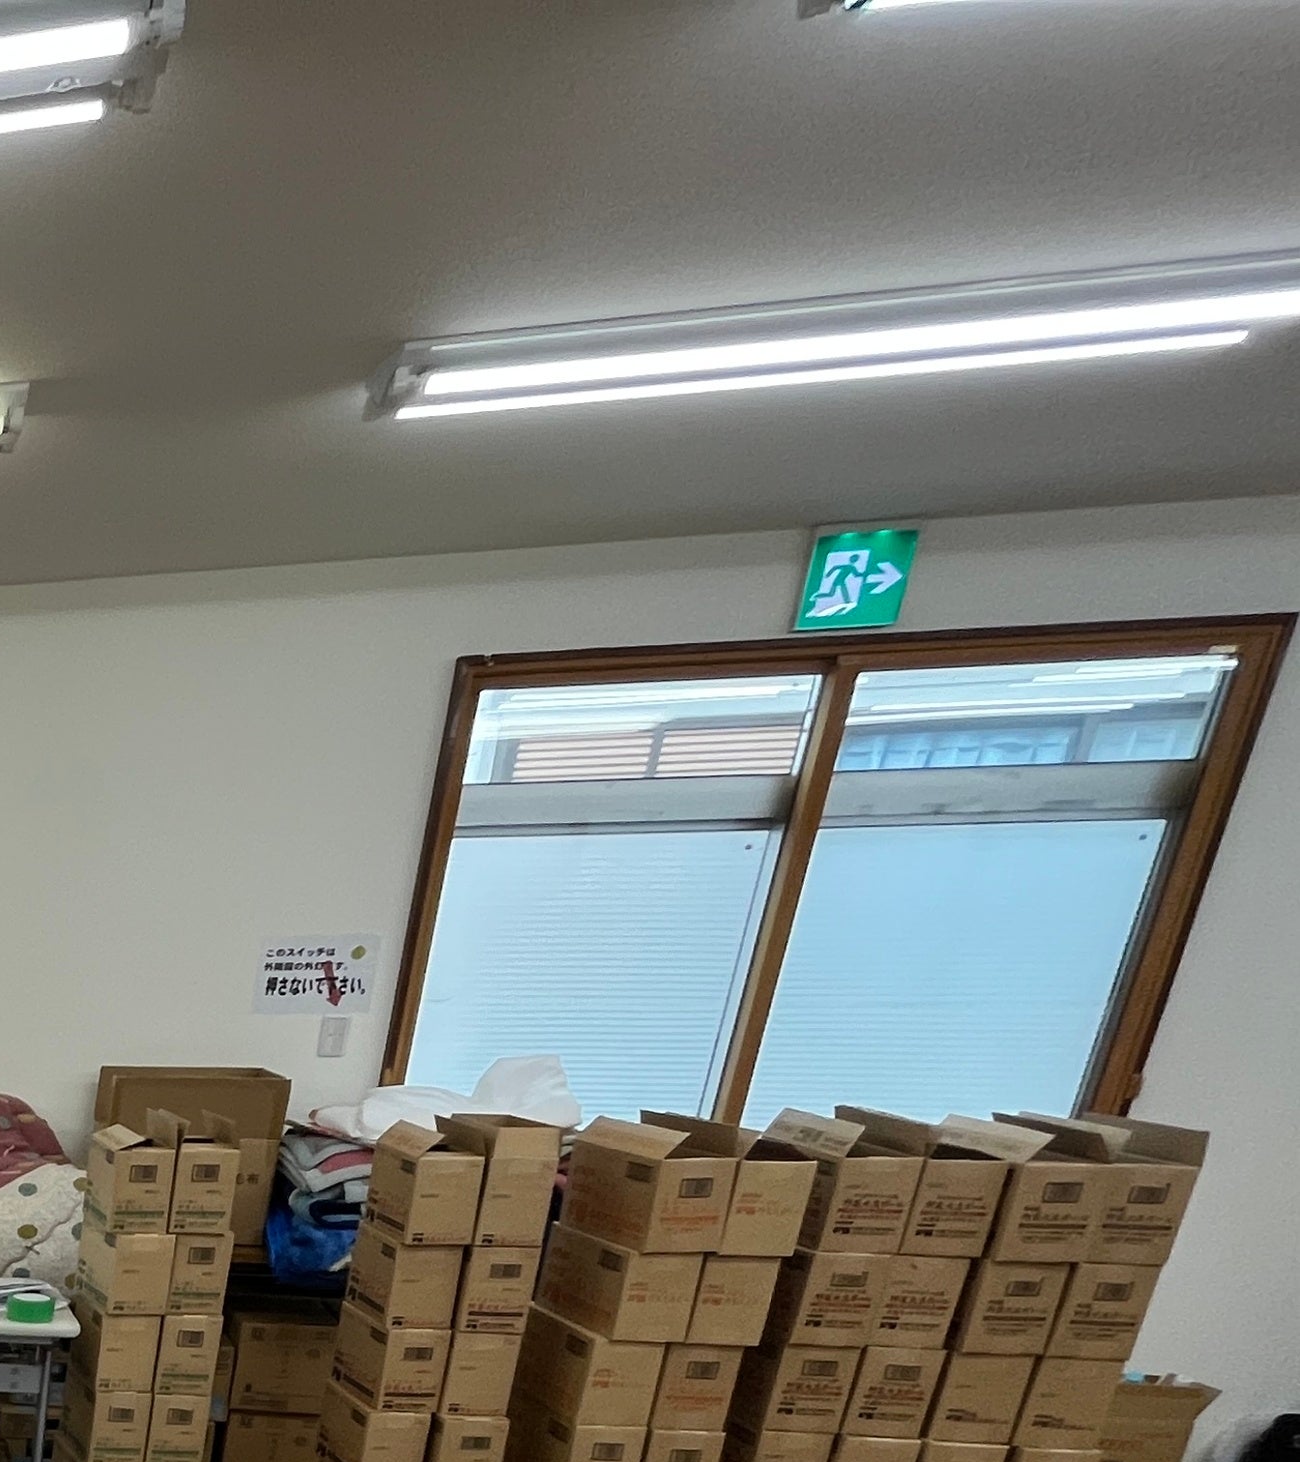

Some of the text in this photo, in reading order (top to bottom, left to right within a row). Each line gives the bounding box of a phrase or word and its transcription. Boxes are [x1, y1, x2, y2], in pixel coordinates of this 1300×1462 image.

[266, 947, 336, 958] このスイッチは
